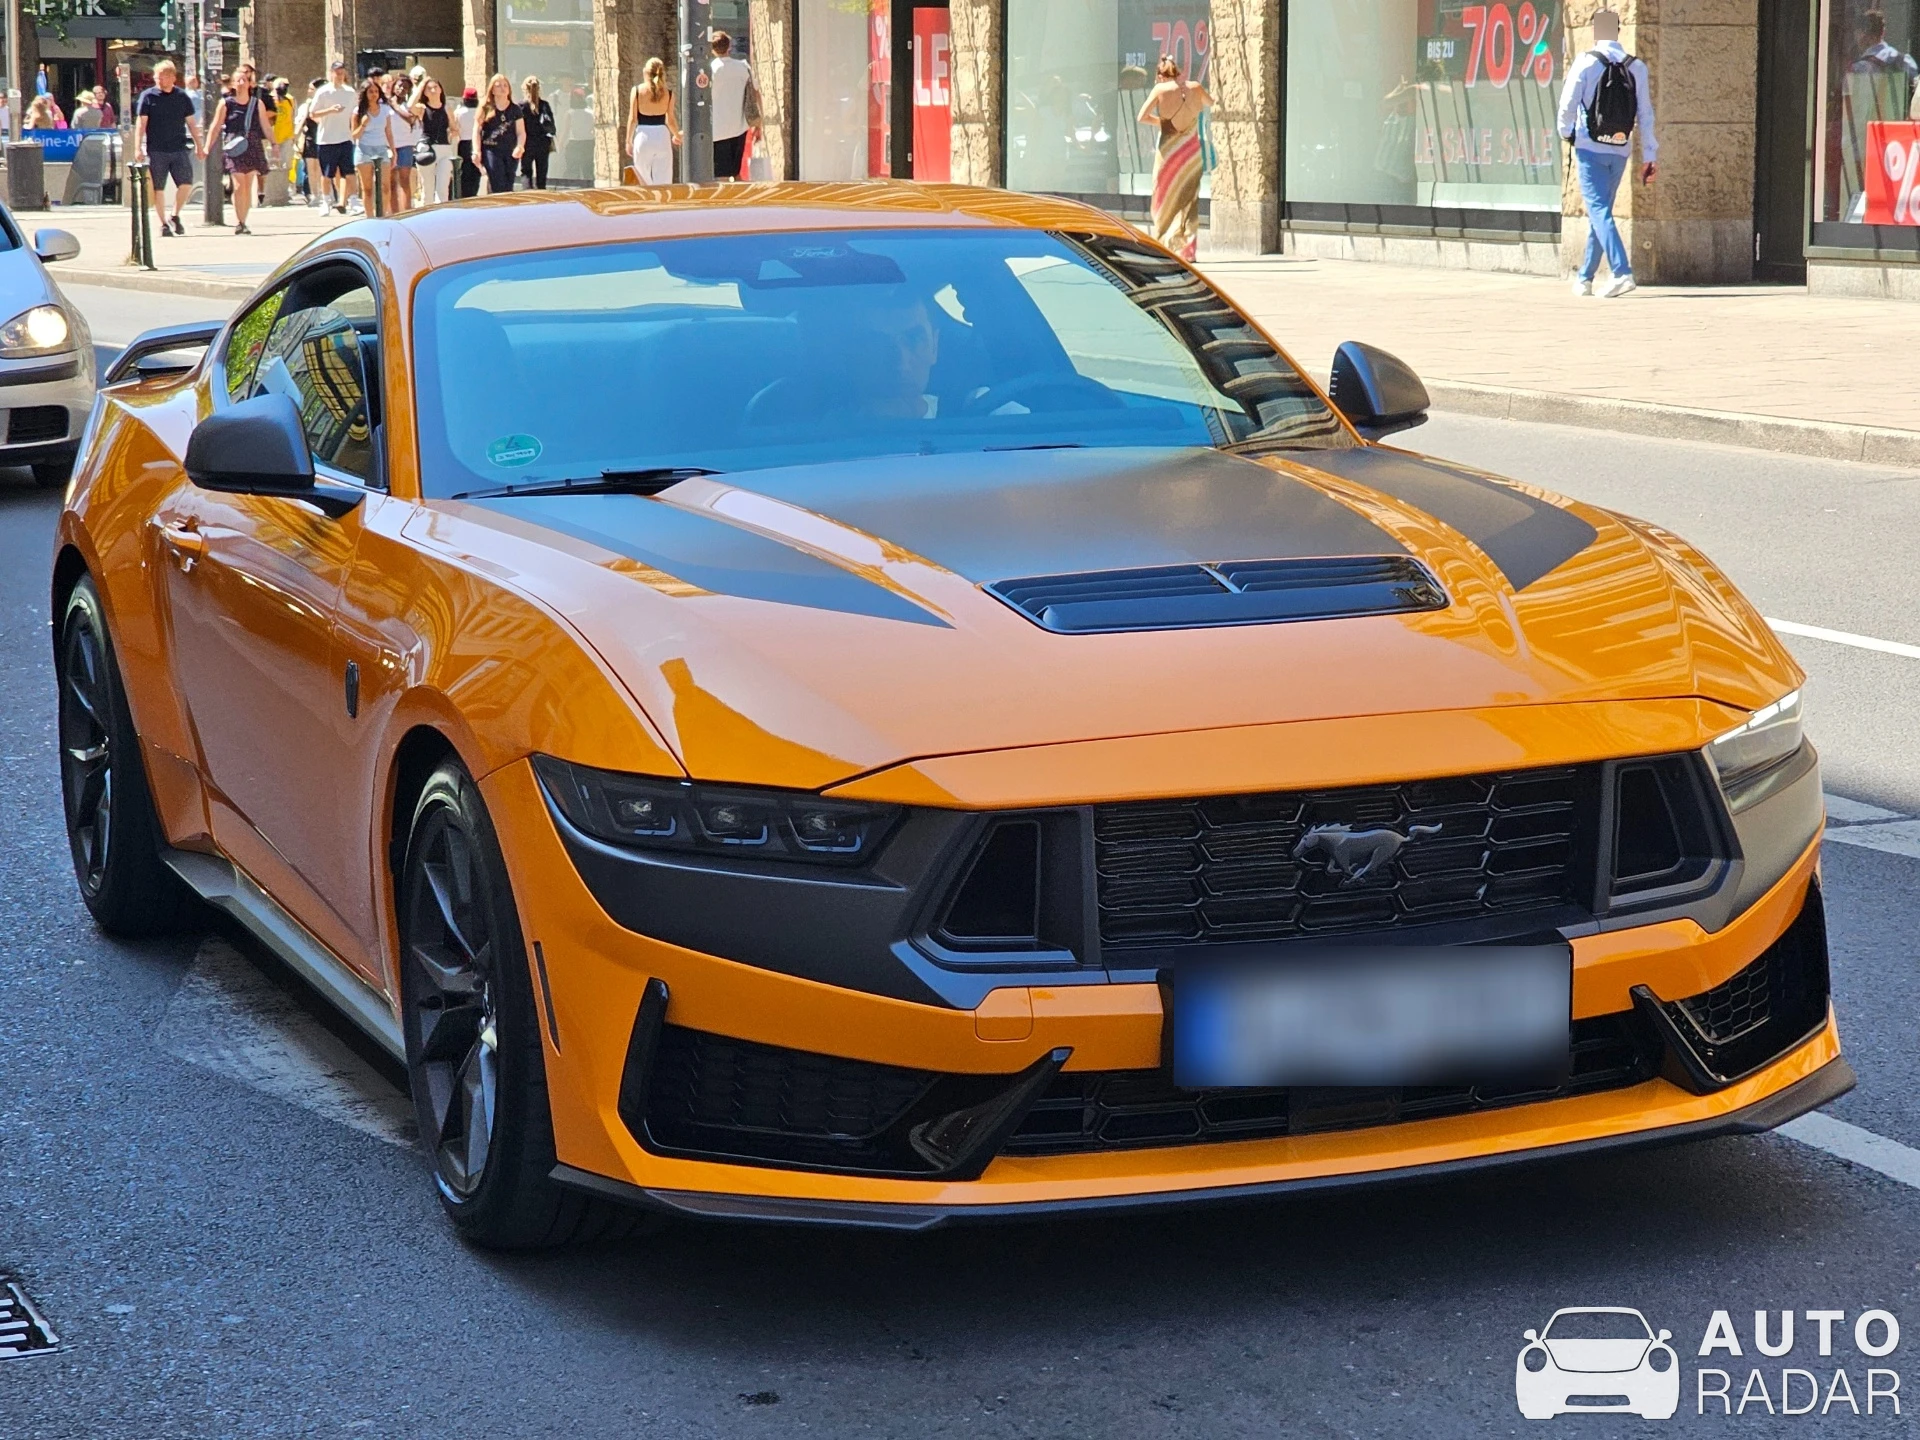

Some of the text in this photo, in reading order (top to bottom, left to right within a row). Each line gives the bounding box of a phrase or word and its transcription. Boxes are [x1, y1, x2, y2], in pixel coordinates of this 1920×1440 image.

[1427, 41, 1441, 59] BIS
[1442, 41, 1455, 58] ZU
[1462, 1, 1554, 89] 70%
[1442, 127, 1492, 165] SALE
[1500, 127, 1553, 166] SALE
